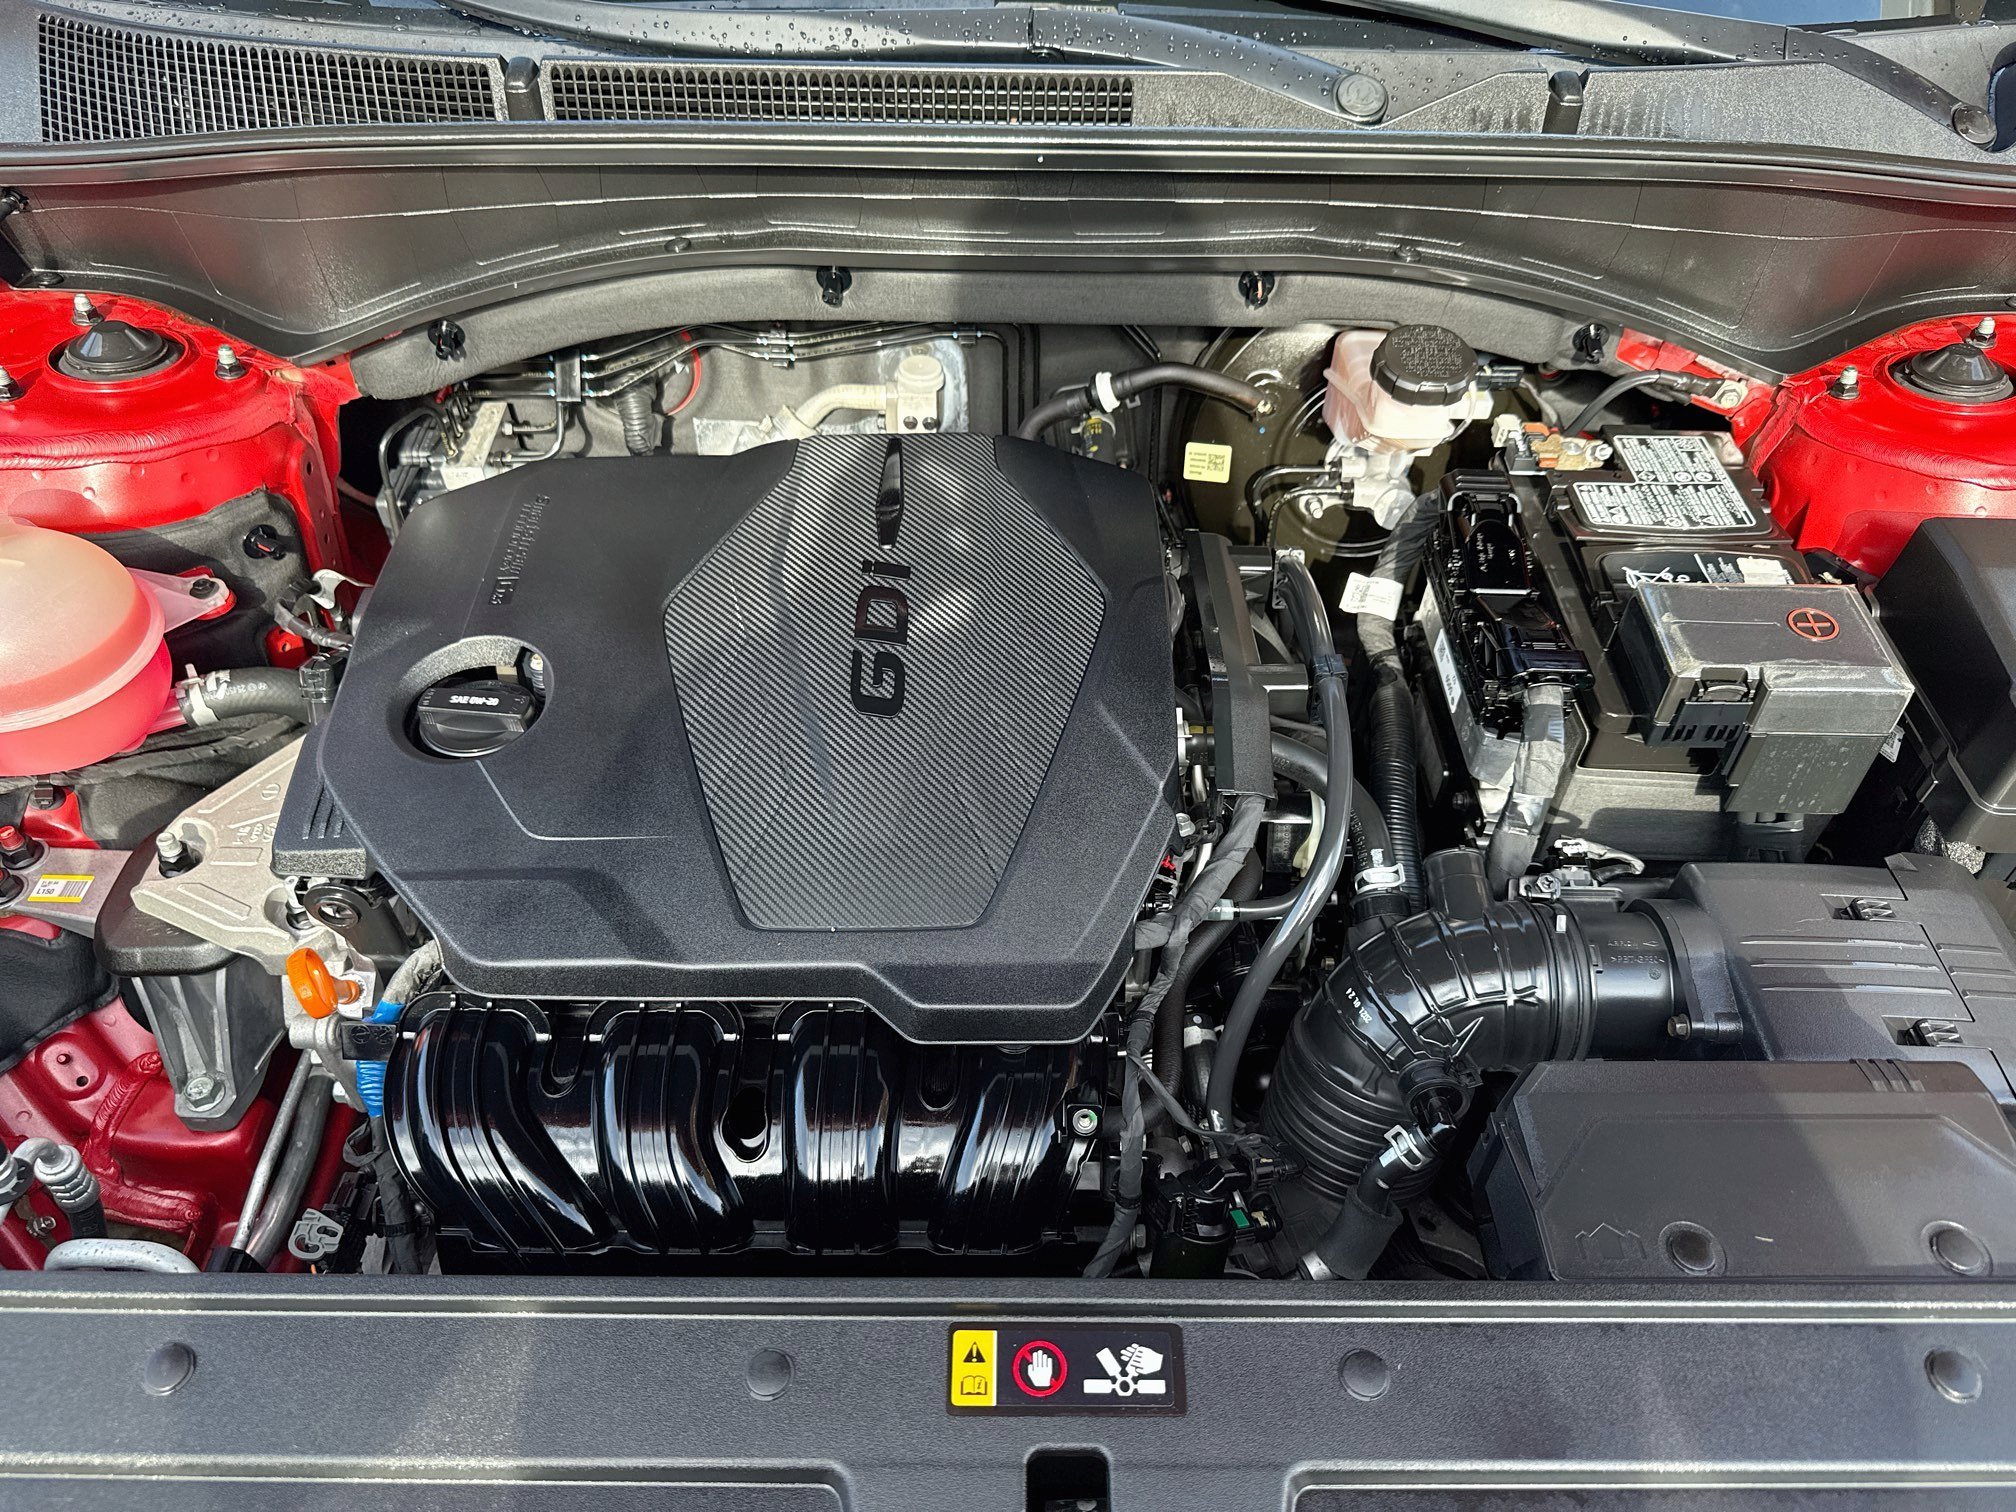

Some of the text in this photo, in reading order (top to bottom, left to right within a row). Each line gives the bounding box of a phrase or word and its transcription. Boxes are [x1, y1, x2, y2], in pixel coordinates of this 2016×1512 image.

[850, 560, 911, 718] GDI
[449, 694, 470, 704] SAE
[1359, 1006, 1373, 1024] 2021
